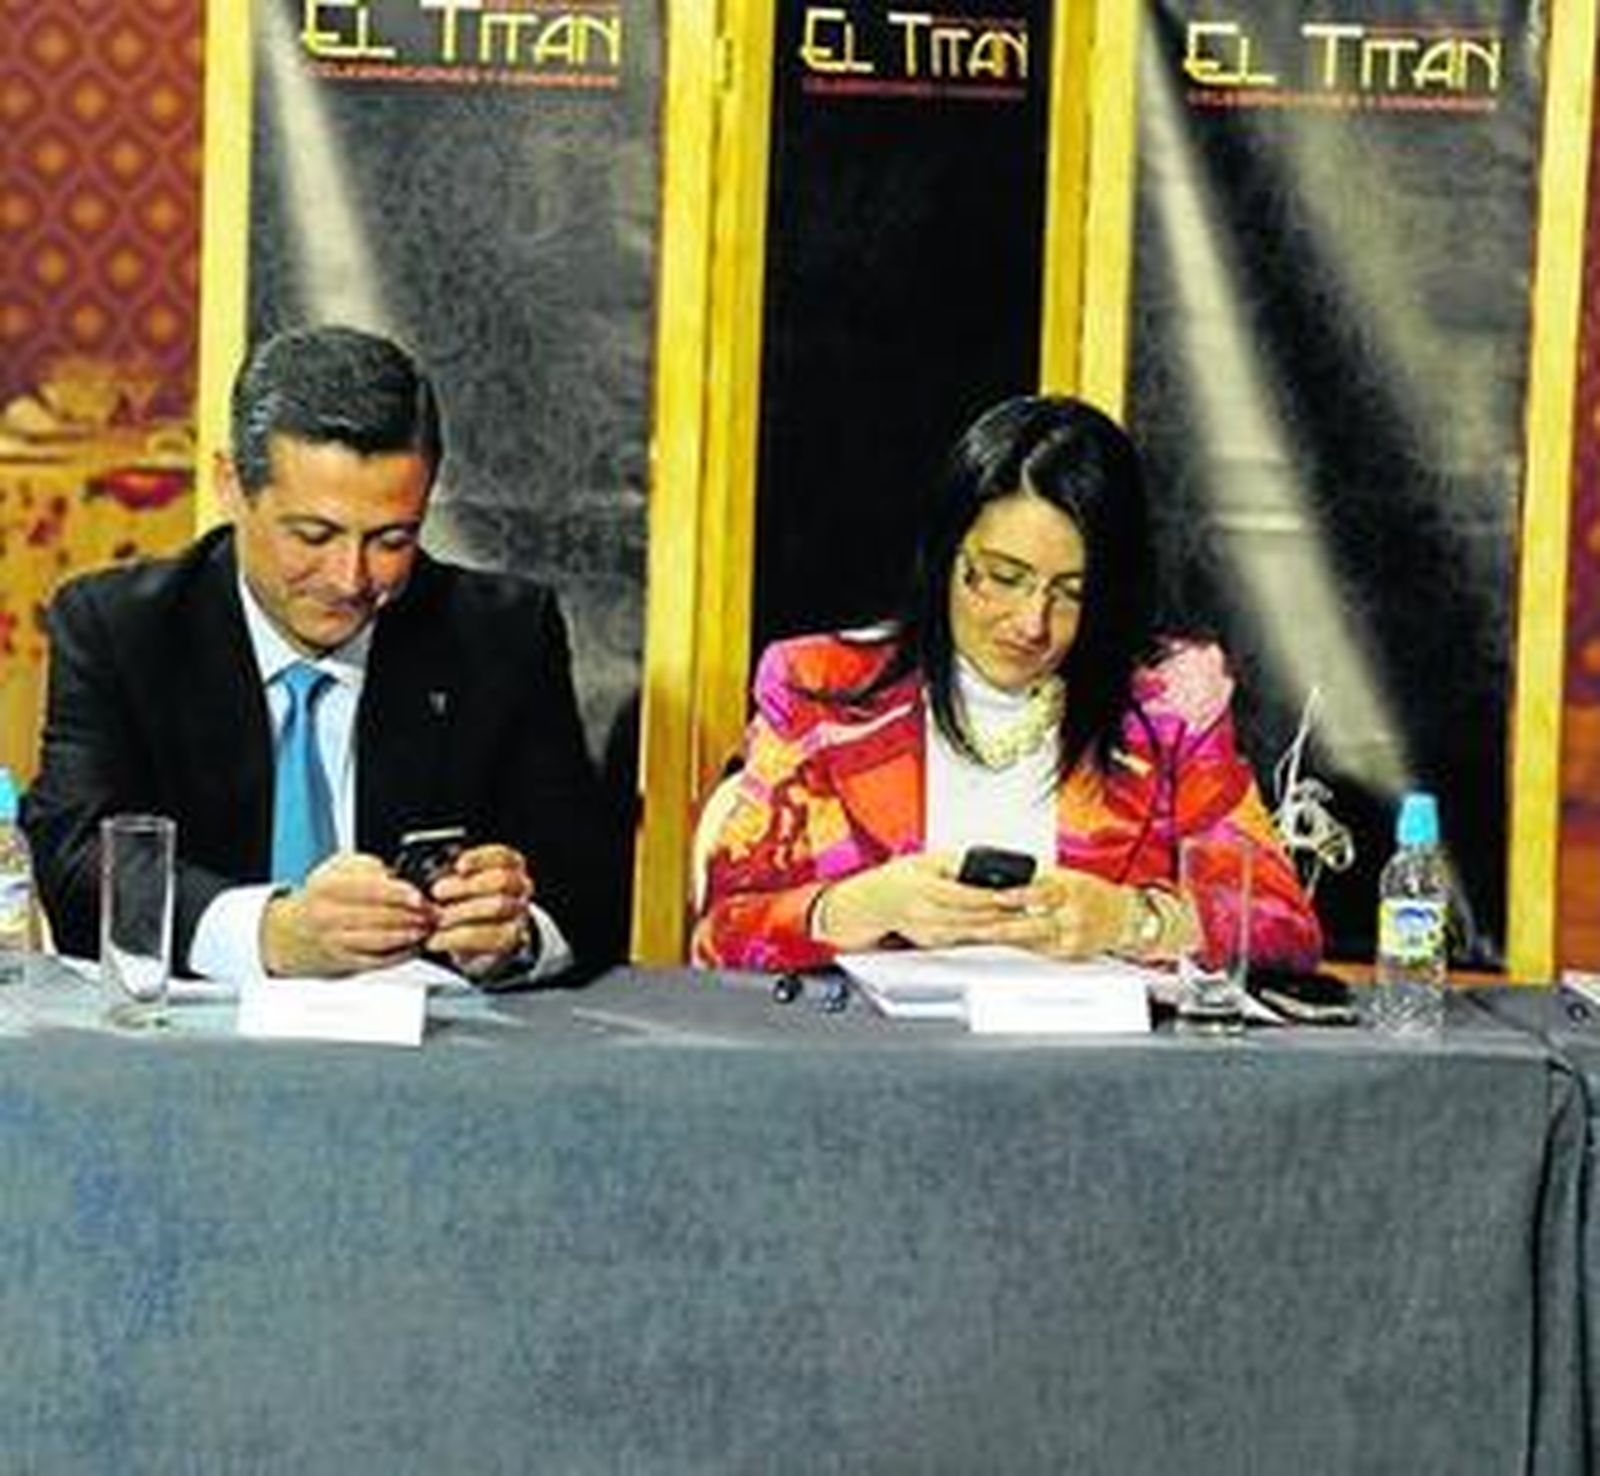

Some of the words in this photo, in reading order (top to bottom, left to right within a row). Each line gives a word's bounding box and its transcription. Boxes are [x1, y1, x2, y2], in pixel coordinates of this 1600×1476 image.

[300, 0, 397, 57] EL
[420, 0, 620, 64] TITAN
[801, 8, 874, 72] EL
[888, 12, 1029, 78] TITAN
[1184, 22, 1276, 84] EL
[1302, 24, 1501, 90] TITAN
